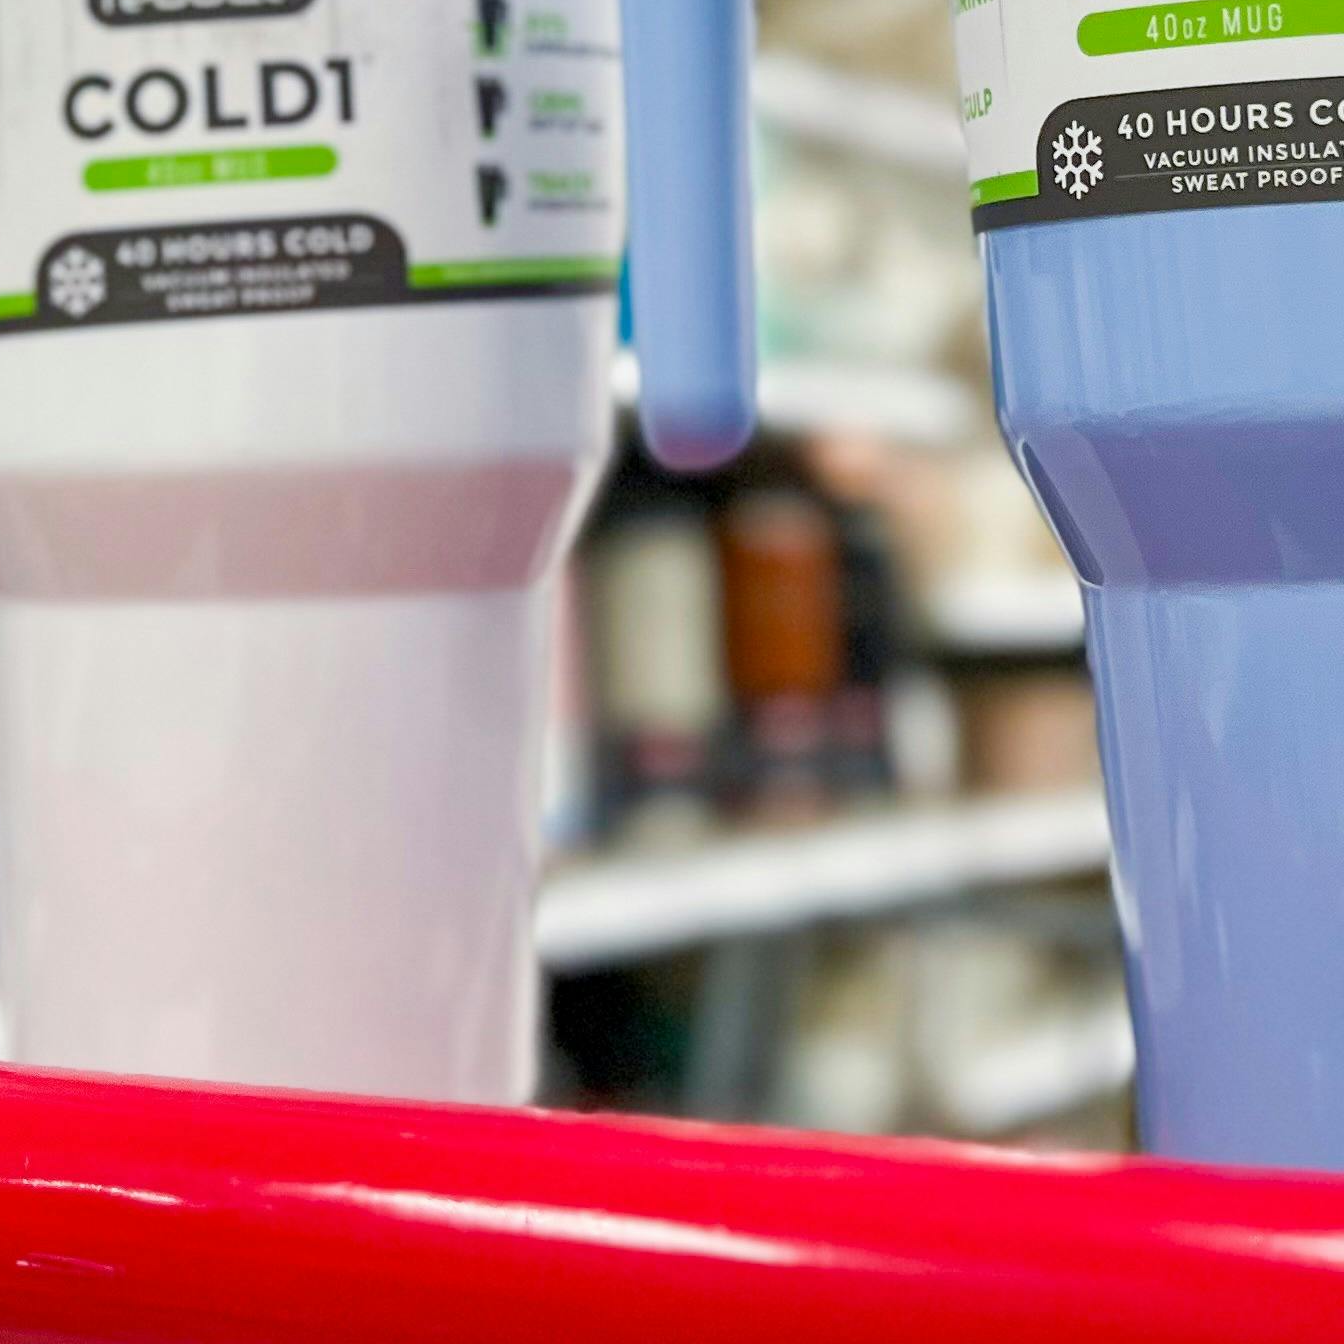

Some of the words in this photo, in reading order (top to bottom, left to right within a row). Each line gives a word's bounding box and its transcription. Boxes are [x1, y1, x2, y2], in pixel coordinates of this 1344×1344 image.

[1146, 12, 1207, 43] 40oz
[1222, 4, 1284, 36] MUG
[63, 59, 355, 141] COLD1
[1117, 112, 1154, 140] 40
[1166, 101, 1294, 136] HOURS
[1143, 147, 1238, 169] VACUUM
[1172, 172, 1248, 193] SWEAT
[1258, 167, 1343, 188] PROOF
